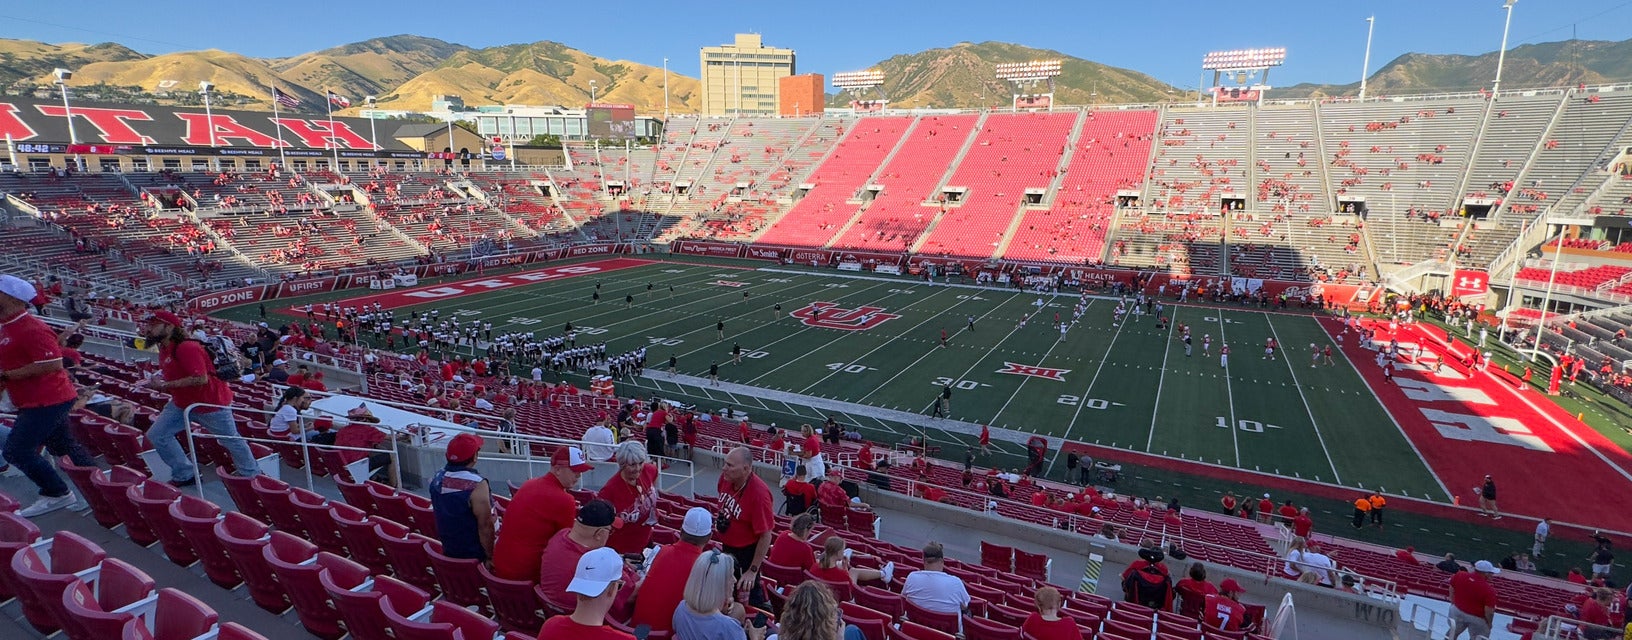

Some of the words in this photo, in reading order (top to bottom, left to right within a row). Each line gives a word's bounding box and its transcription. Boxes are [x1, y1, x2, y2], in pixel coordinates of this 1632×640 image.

[17, 144, 49, 153] 48:42
[1085, 272, 1114, 281] HEALTH
[222, 291, 254, 303] ZONE
[825, 362, 867, 374] 40
[931, 376, 978, 391] 30
[1056, 394, 1109, 410] 20
[1215, 416, 1264, 433] 10
[718, 492, 743, 519] UTAH
[1217, 612, 1229, 631] 7
